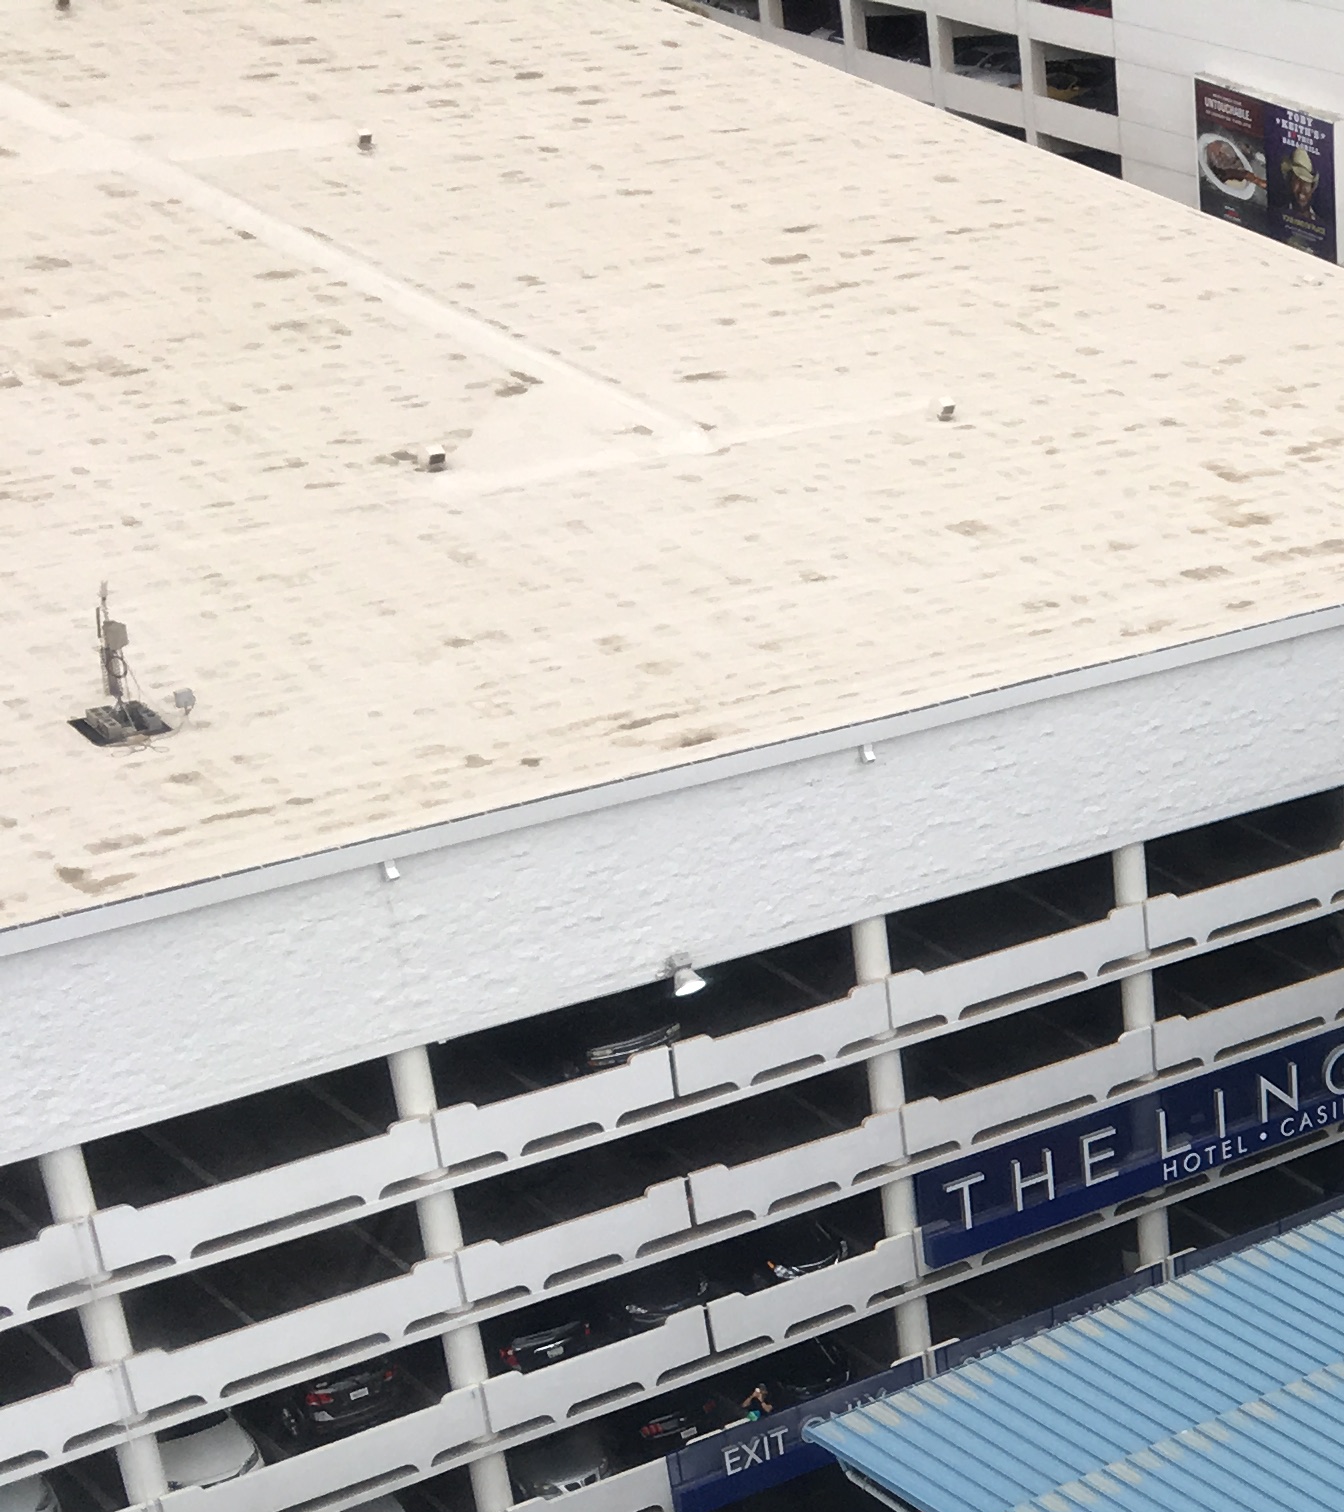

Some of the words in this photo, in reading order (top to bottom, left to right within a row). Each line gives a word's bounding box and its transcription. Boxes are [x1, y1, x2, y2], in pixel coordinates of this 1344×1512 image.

[1287, 111, 1313, 127] TOBY
[943, 1126, 1120, 1231] THE
[1163, 1135, 1247, 1181] HOTEL
[724, 1427, 789, 1476] EXIT
